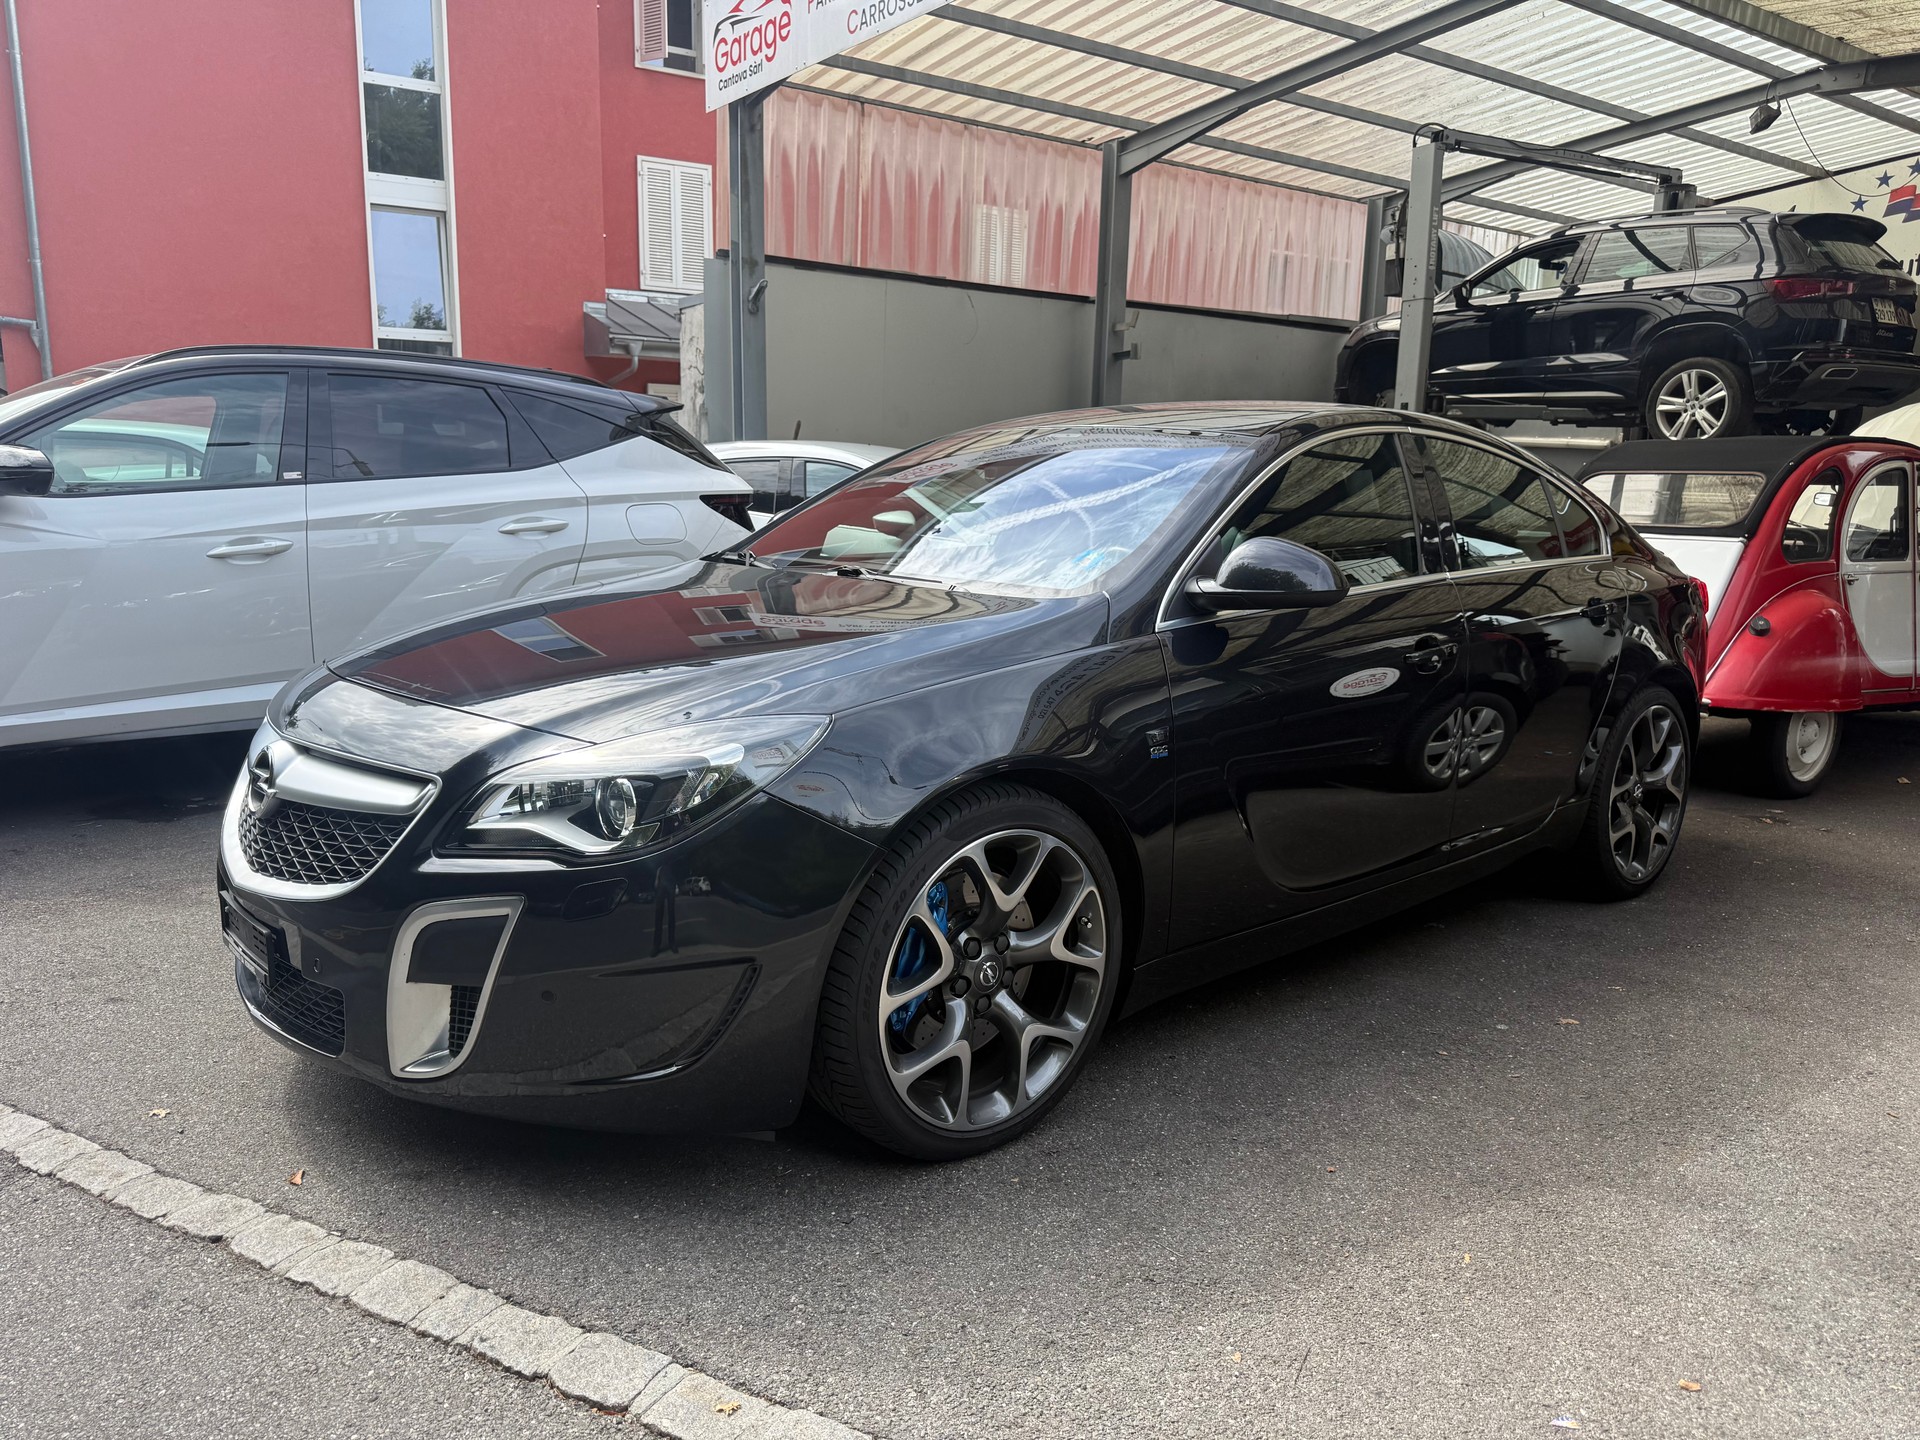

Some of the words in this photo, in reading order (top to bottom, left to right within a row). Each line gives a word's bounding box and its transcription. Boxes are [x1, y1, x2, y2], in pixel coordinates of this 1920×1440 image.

[714, 10, 791, 73] Garage
[718, 69, 748, 91] Cantova
[748, 59, 763, 77] Sàrl
[1431, 206, 1439, 226] LIFT
[1429, 228, 1438, 265] ROTARY
